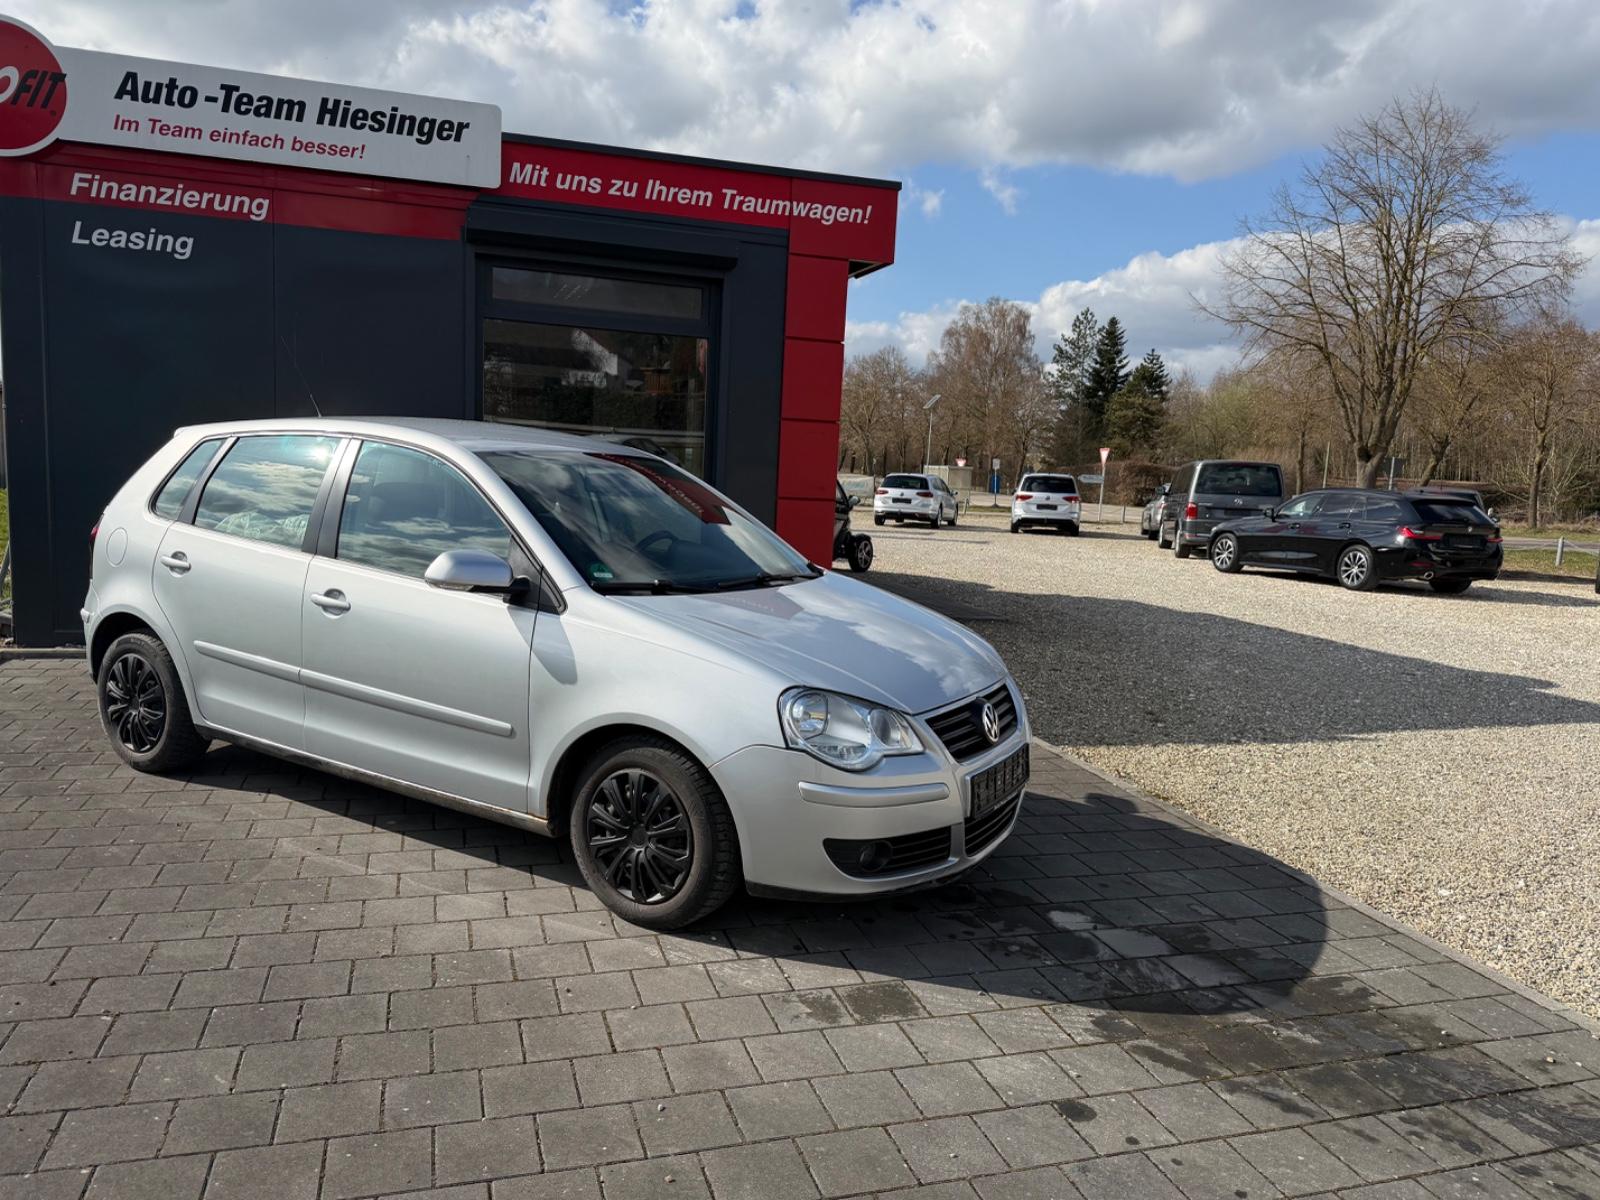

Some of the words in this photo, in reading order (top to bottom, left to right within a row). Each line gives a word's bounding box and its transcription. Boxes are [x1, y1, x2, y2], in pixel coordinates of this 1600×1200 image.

[113, 114, 140, 133] Im
[148, 118, 203, 141] Team
[209, 127, 285, 150] einfach
[290, 136, 366, 160] besser!
[316, 97, 471, 145] Hiesinger
[70, 172, 270, 221] Finanzierung
[509, 162, 550, 188] Mit
[555, 172, 602, 194] uns
[608, 179, 639, 198] zu
[644, 179, 713, 208] Ihrem
[722, 188, 873, 226] Traumwagen!
[71, 220, 194, 260] Leasing
